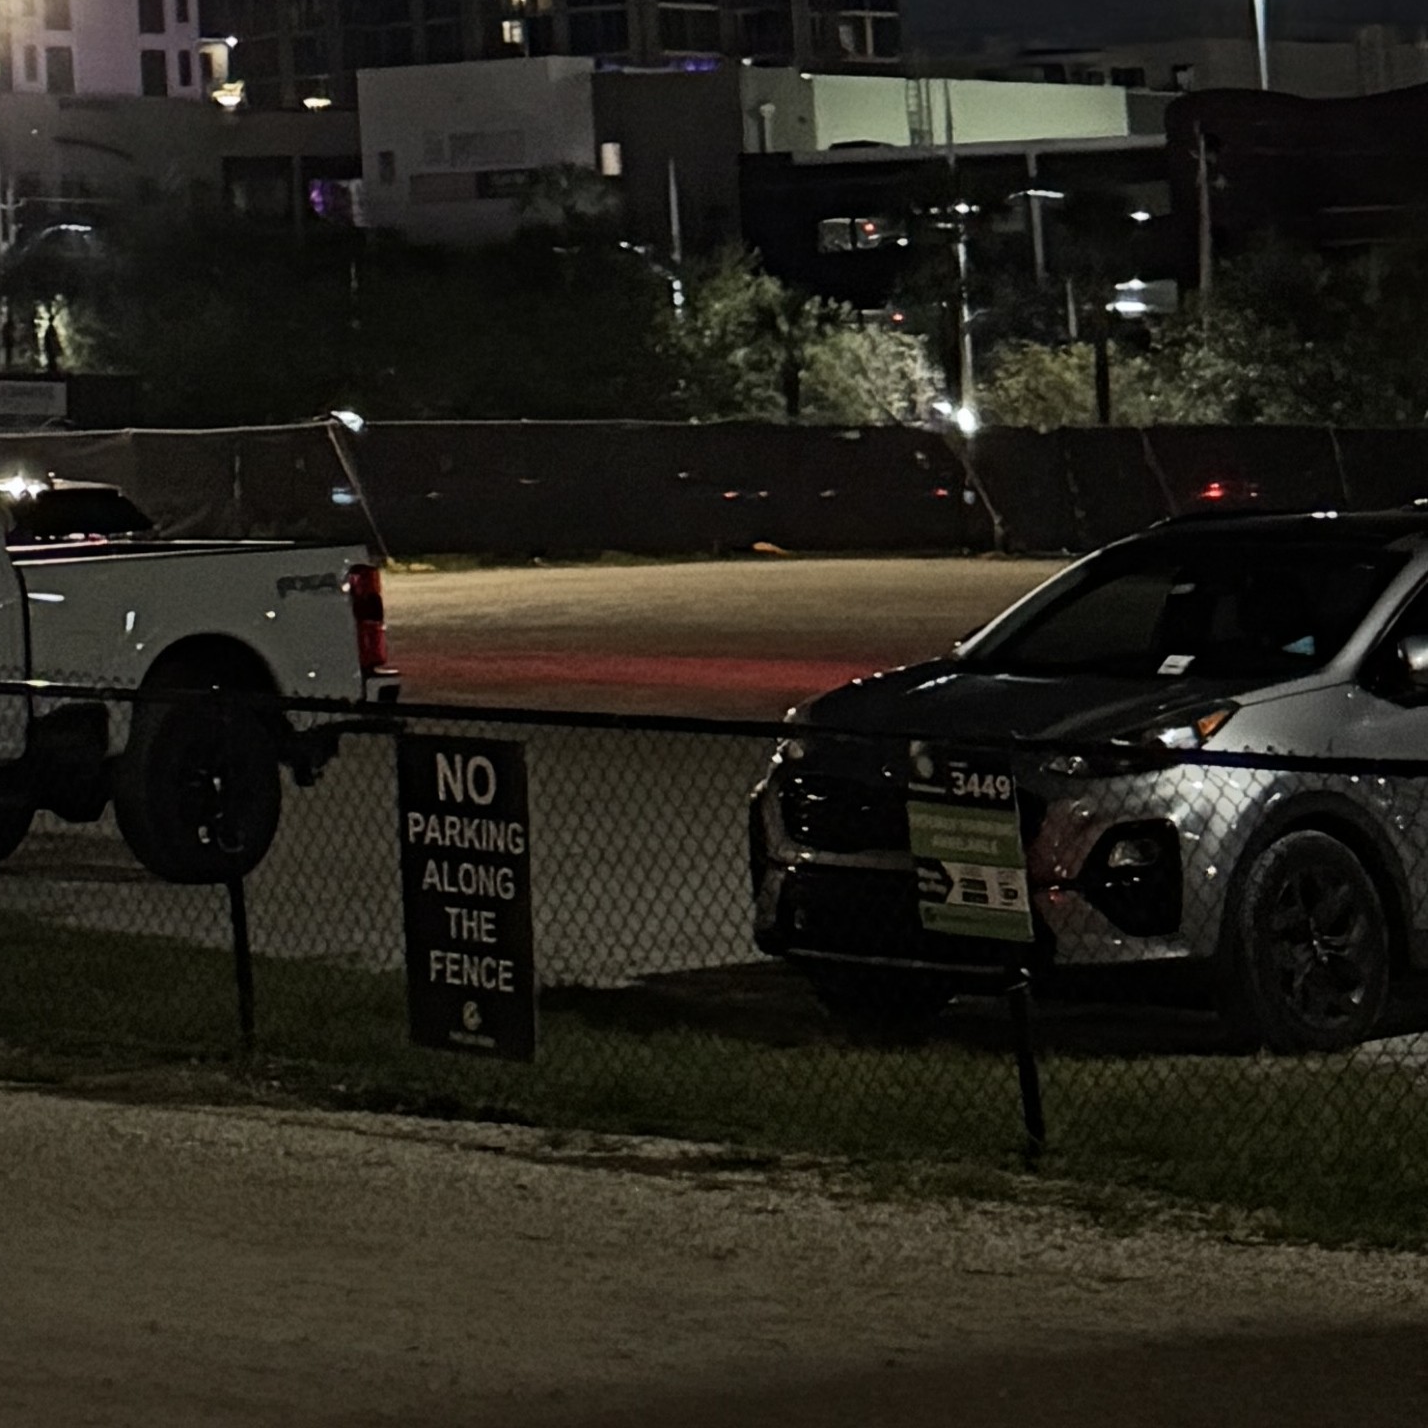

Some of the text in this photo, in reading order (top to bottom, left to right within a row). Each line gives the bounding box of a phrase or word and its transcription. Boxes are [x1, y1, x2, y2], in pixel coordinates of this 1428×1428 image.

[435, 751, 497, 806] NO
[950, 771, 1012, 801] 3449
[406, 810, 526, 856] PARKING
[421, 858, 516, 901] ALONG
[444, 905, 499, 944] THE
[428, 948, 516, 994] FENCE
